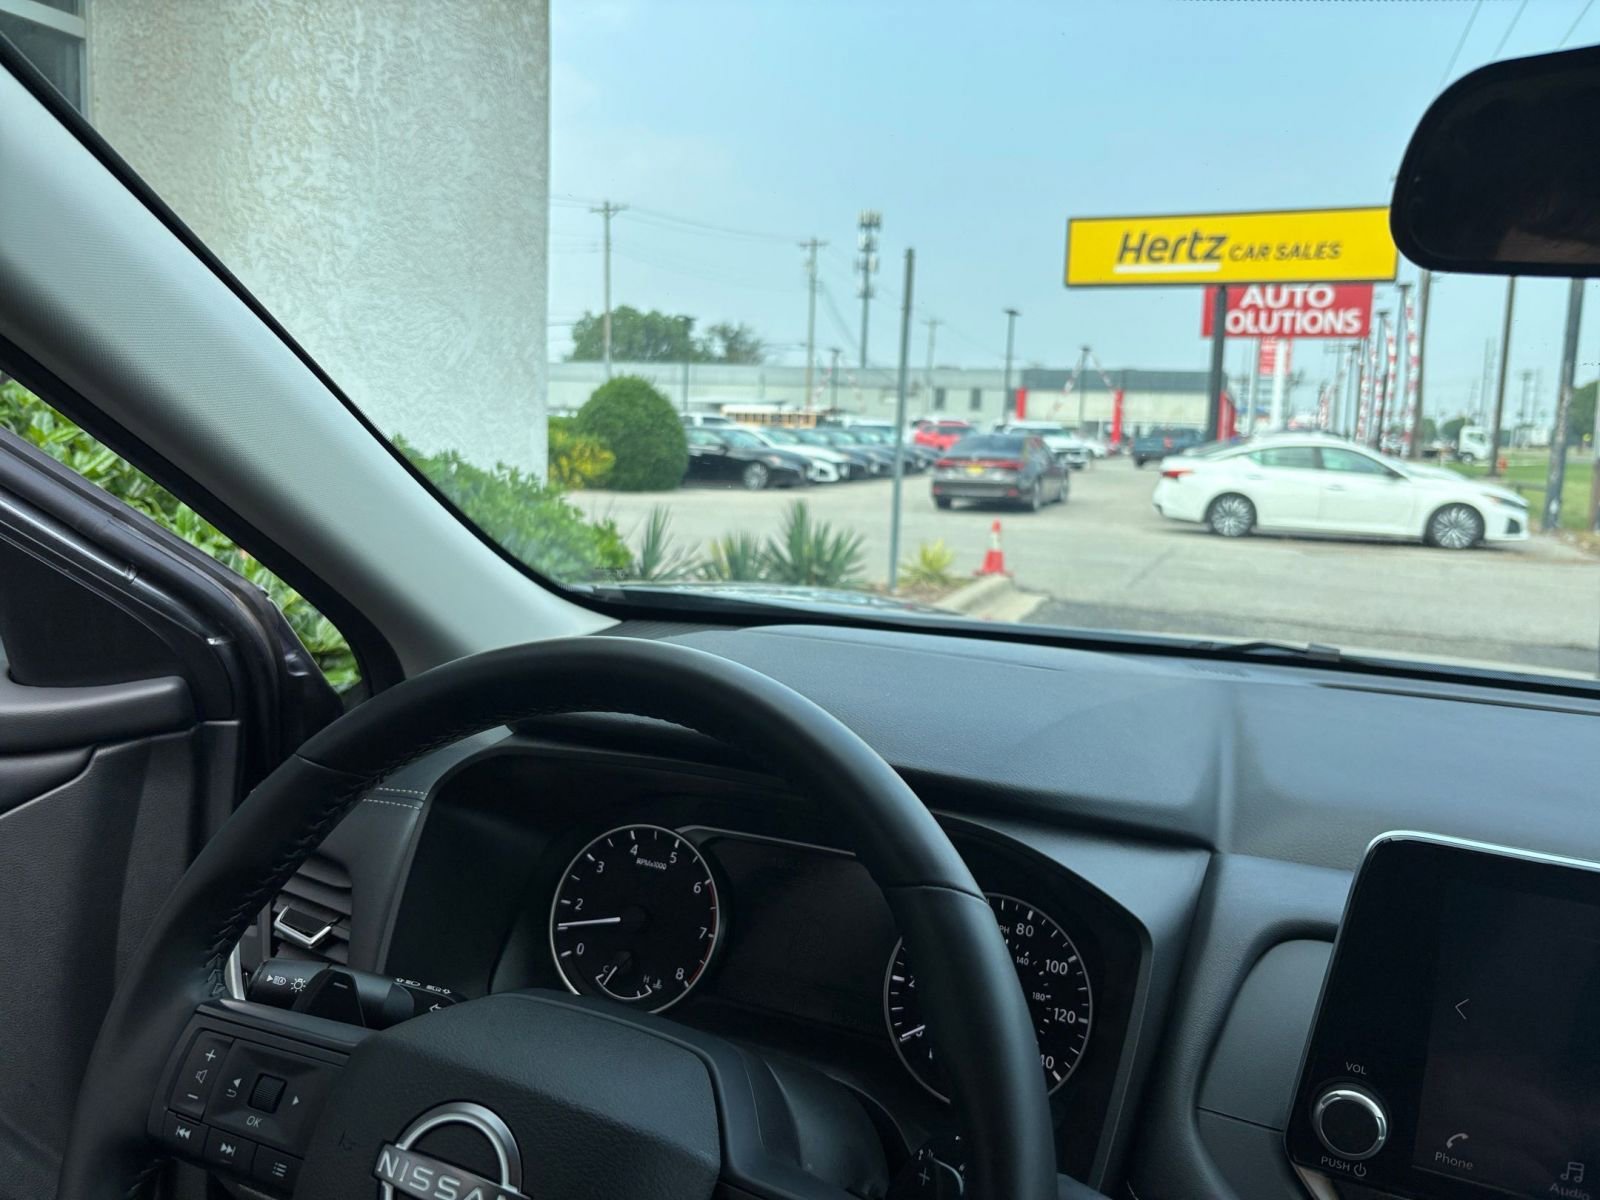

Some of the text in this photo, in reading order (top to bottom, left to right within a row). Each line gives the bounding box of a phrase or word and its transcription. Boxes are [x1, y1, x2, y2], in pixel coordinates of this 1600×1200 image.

[1117, 231, 1342, 263] Hertz CAR SALES
[1240, 284, 1336, 309] AUTO
[1225, 309, 1362, 335] OLUTIONS
[630, 844, 639, 856] 4
[669, 851, 678, 864] 5
[596, 861, 604, 874] 3
[693, 881, 702, 894] 6
[574, 898, 584, 911] 2
[699, 927, 706, 940] 7
[1016, 923, 1034, 937] 80
[576, 943, 585, 956] 0
[1016, 956, 1030, 966] 140
[1045, 959, 1068, 975] 100
[675, 967, 684, 981] 8
[1032, 992, 1046, 1001] 180
[1053, 1007, 1076, 1024] 120
[1040, 1054, 1054, 1069] 40
[1345, 1061, 1367, 1075] VOL
[246, 1115, 262, 1128] OK
[1321, 1155, 1351, 1172] PUSH
[1435, 1151, 1474, 1170] Phone
[377, 1150, 508, 1200] NISSA
[1550, 1182, 1591, 1200] Audio
